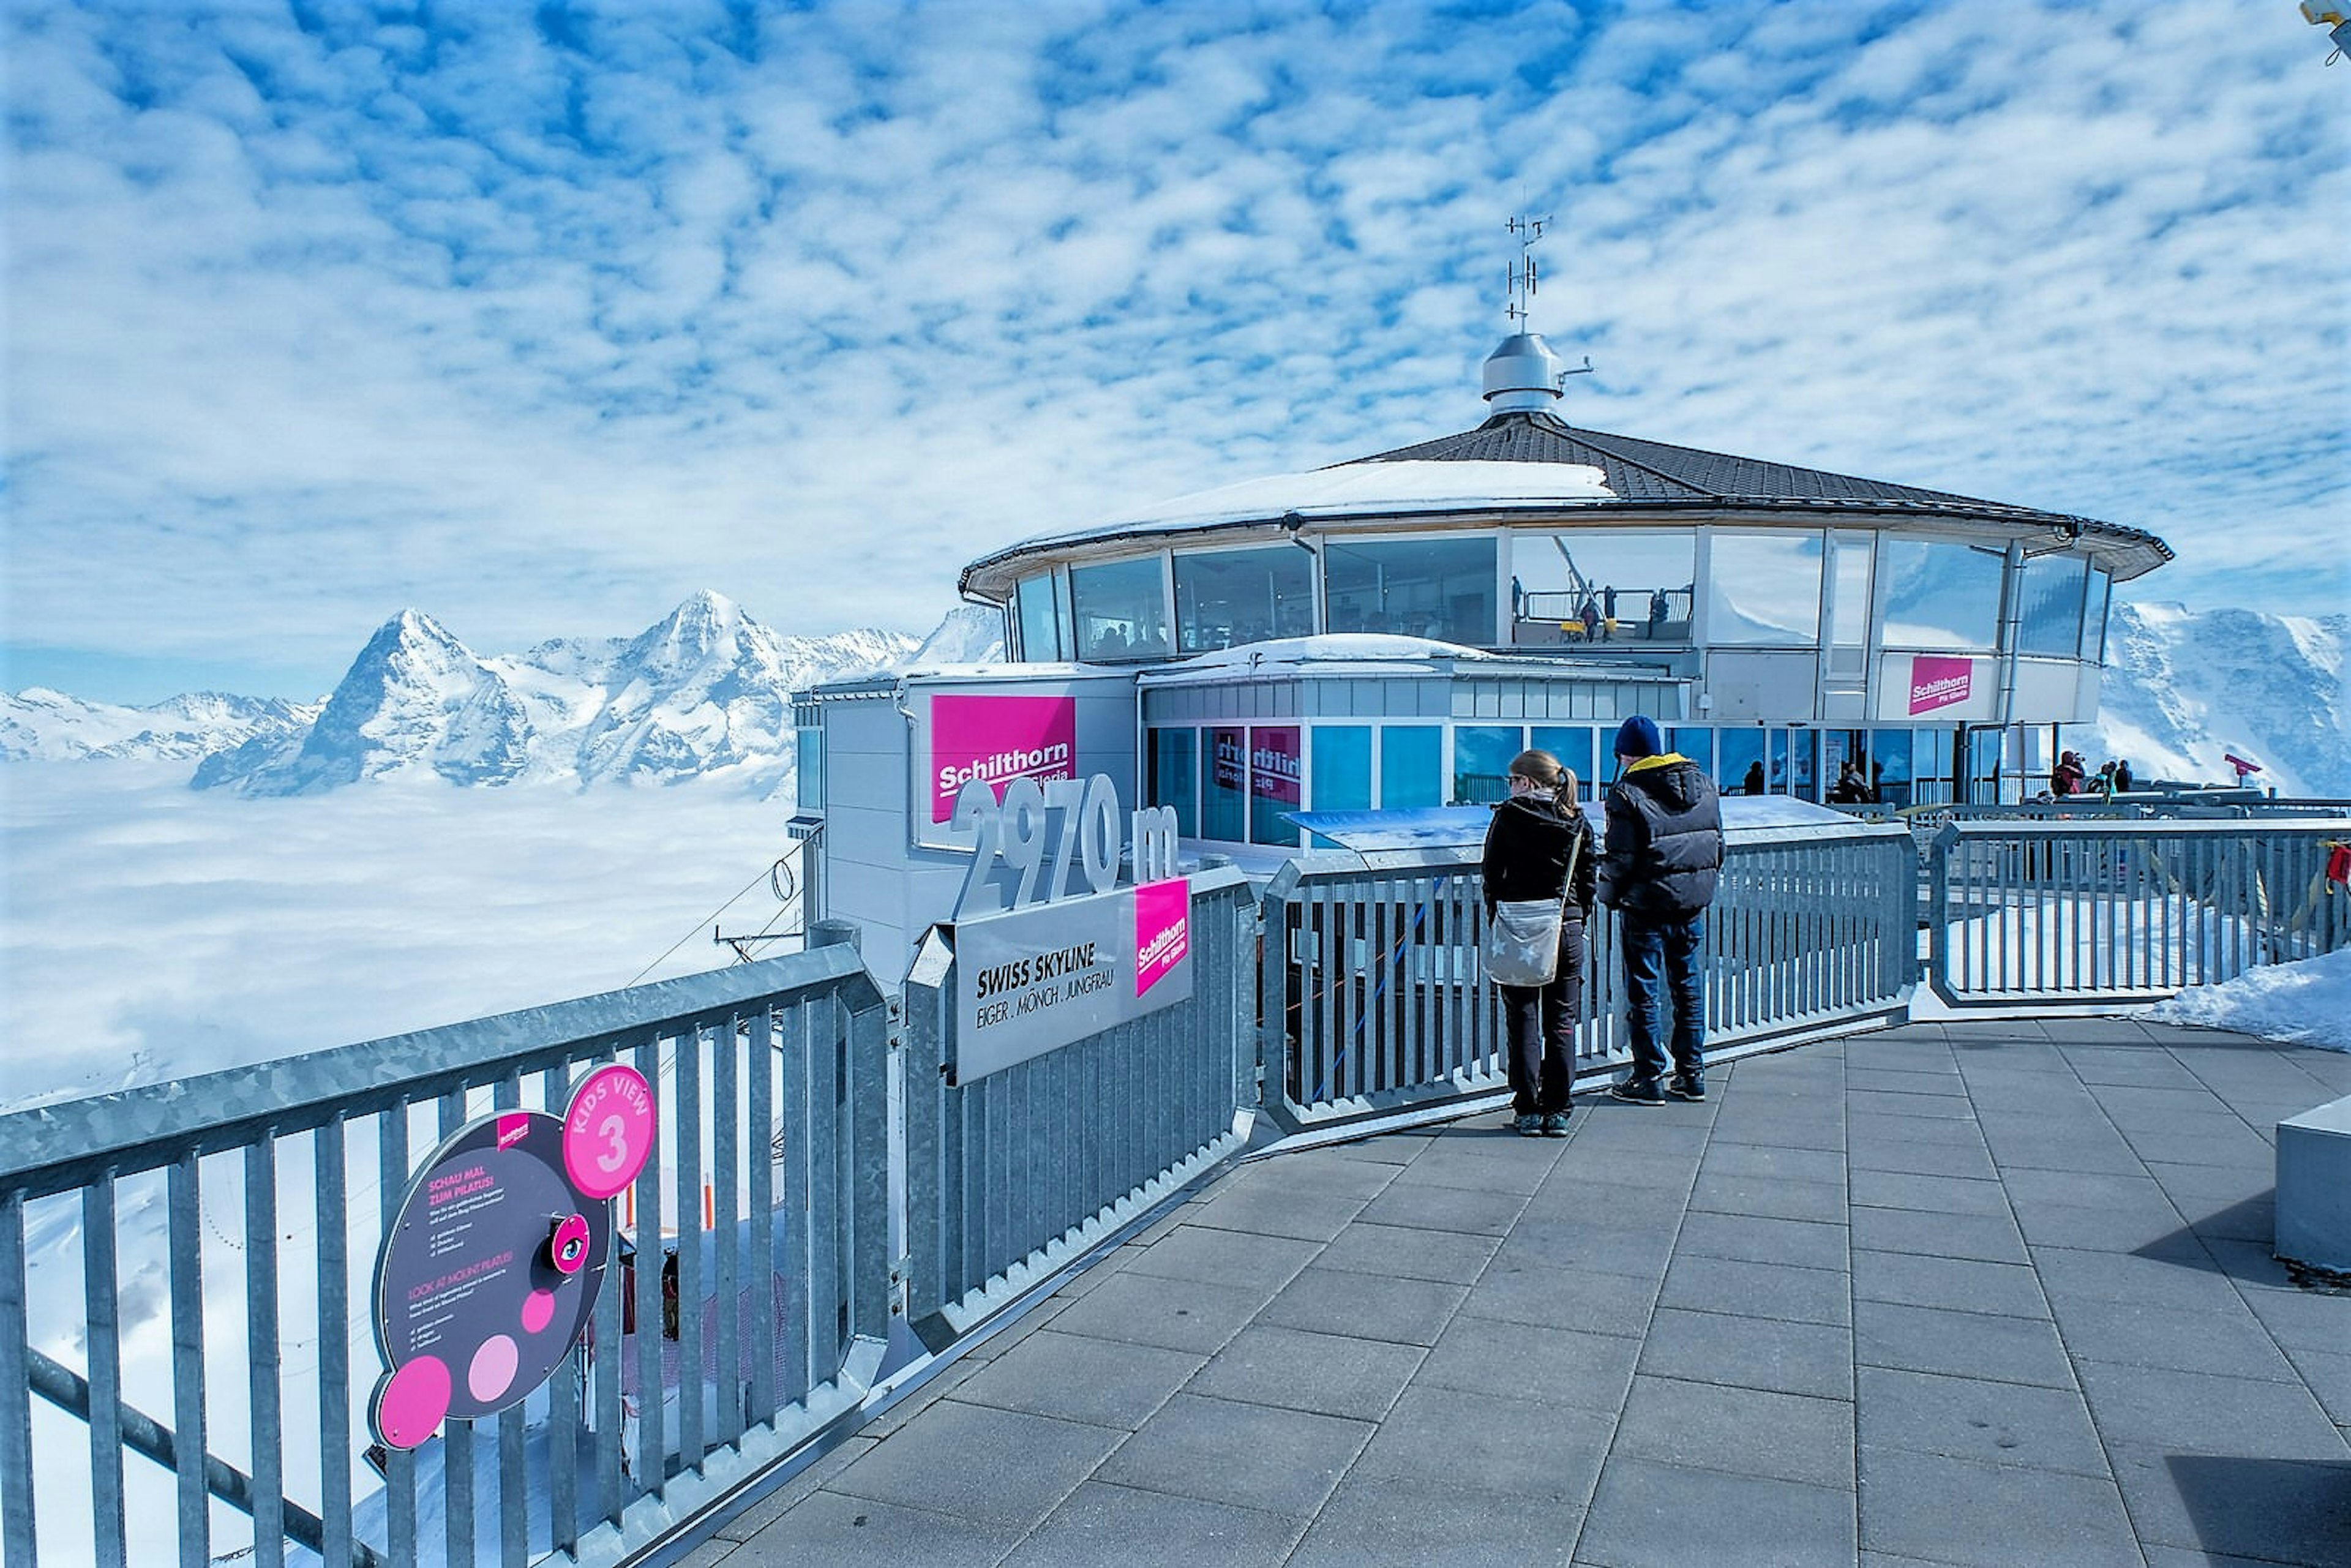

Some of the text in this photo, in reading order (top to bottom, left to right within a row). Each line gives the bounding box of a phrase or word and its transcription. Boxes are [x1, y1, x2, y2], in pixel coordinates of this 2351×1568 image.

[1913, 675, 1968, 697] Schilthorn
[939, 742, 1068, 789] Schilthorn
[951, 773, 1179, 922] 2970 m
[1138, 918, 1185, 968] Schilthorn
[977, 942, 1095, 999] SWISS SKYLINE
[977, 1000, 1009, 1029] EIGER
[1016, 987, 1059, 1016] MÖNCH
[1065, 969, 1115, 1000] JUNGFRAU
[573, 1076, 648, 1133] KIDS VIEW
[597, 1114, 628, 1173] 3
[429, 1166, 486, 1191] SCHAU MAL
[429, 1190, 453, 1206] ZUM
[408, 1281, 435, 1300] LOOK
